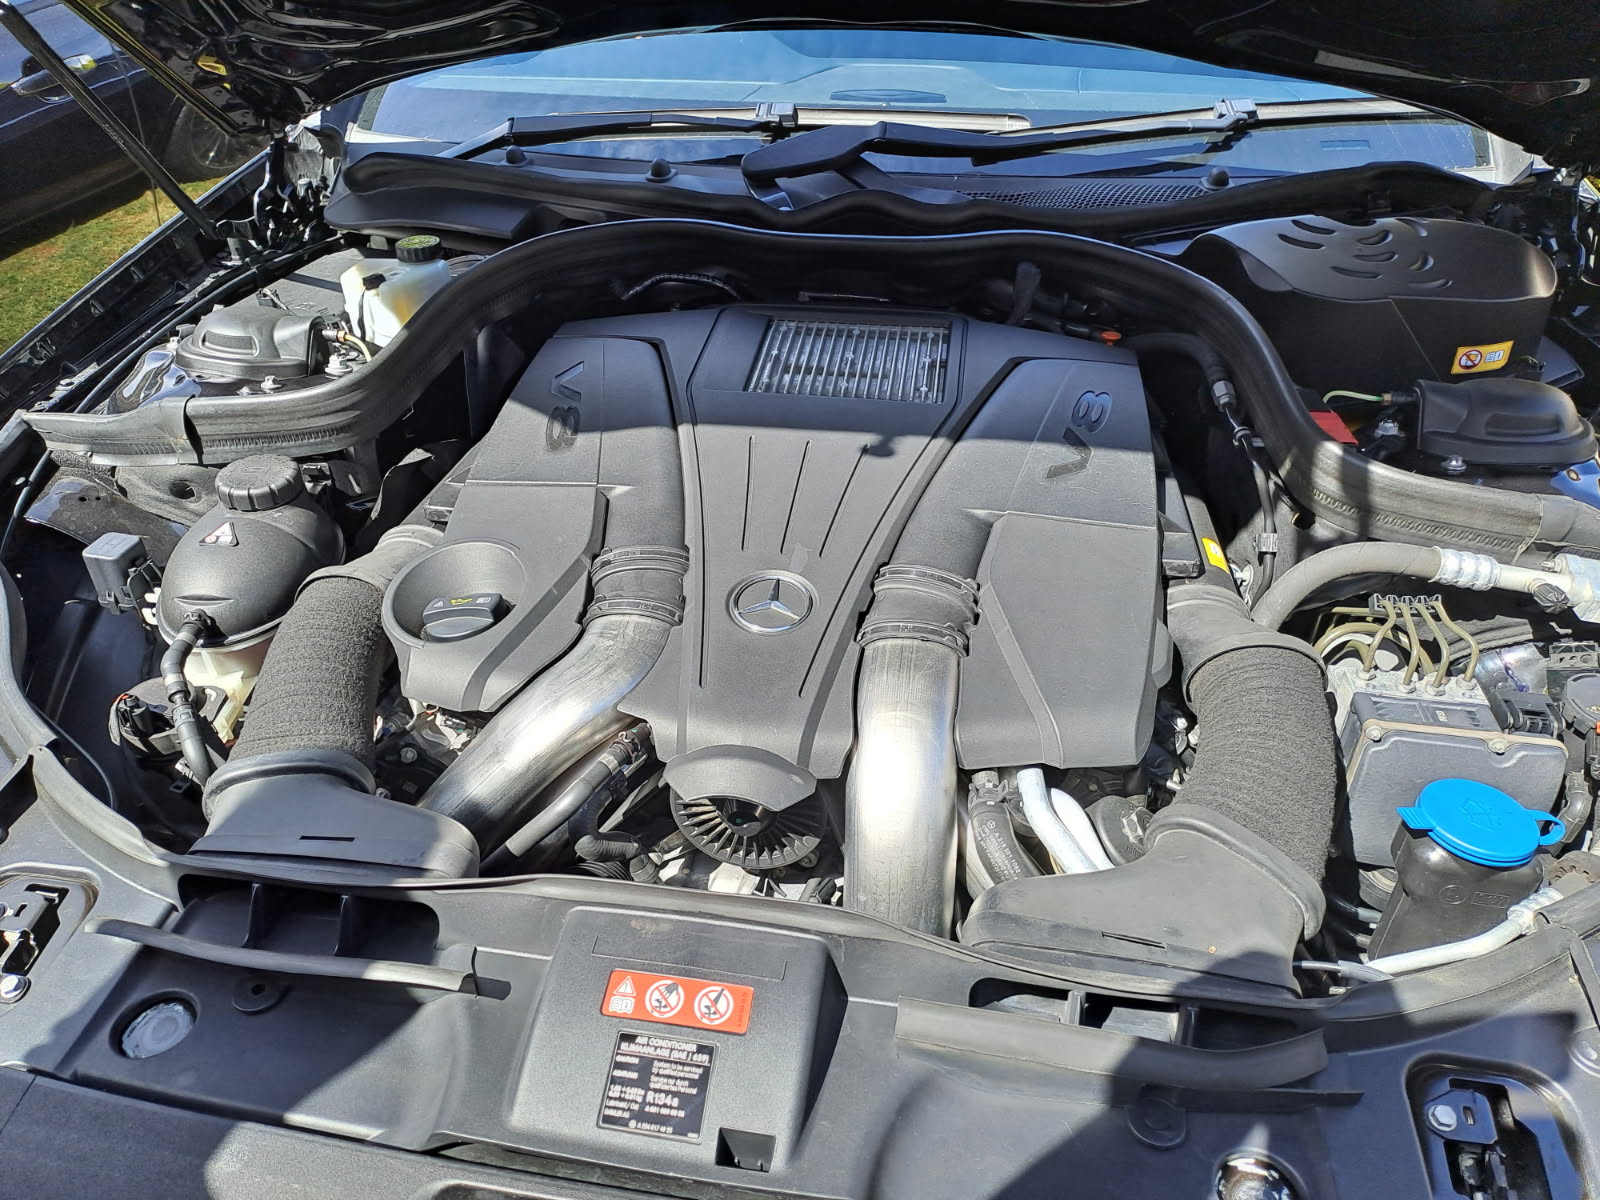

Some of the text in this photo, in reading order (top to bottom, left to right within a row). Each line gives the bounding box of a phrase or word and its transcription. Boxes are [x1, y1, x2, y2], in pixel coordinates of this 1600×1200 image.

[546, 360, 585, 451] V8
[1045, 390, 1113, 479] V8
[621, 1042, 670, 1057] KLIMAANLAGE
[636, 1036, 697, 1052] AIR CONDITIONER
[646, 1091, 679, 1107] R134a
